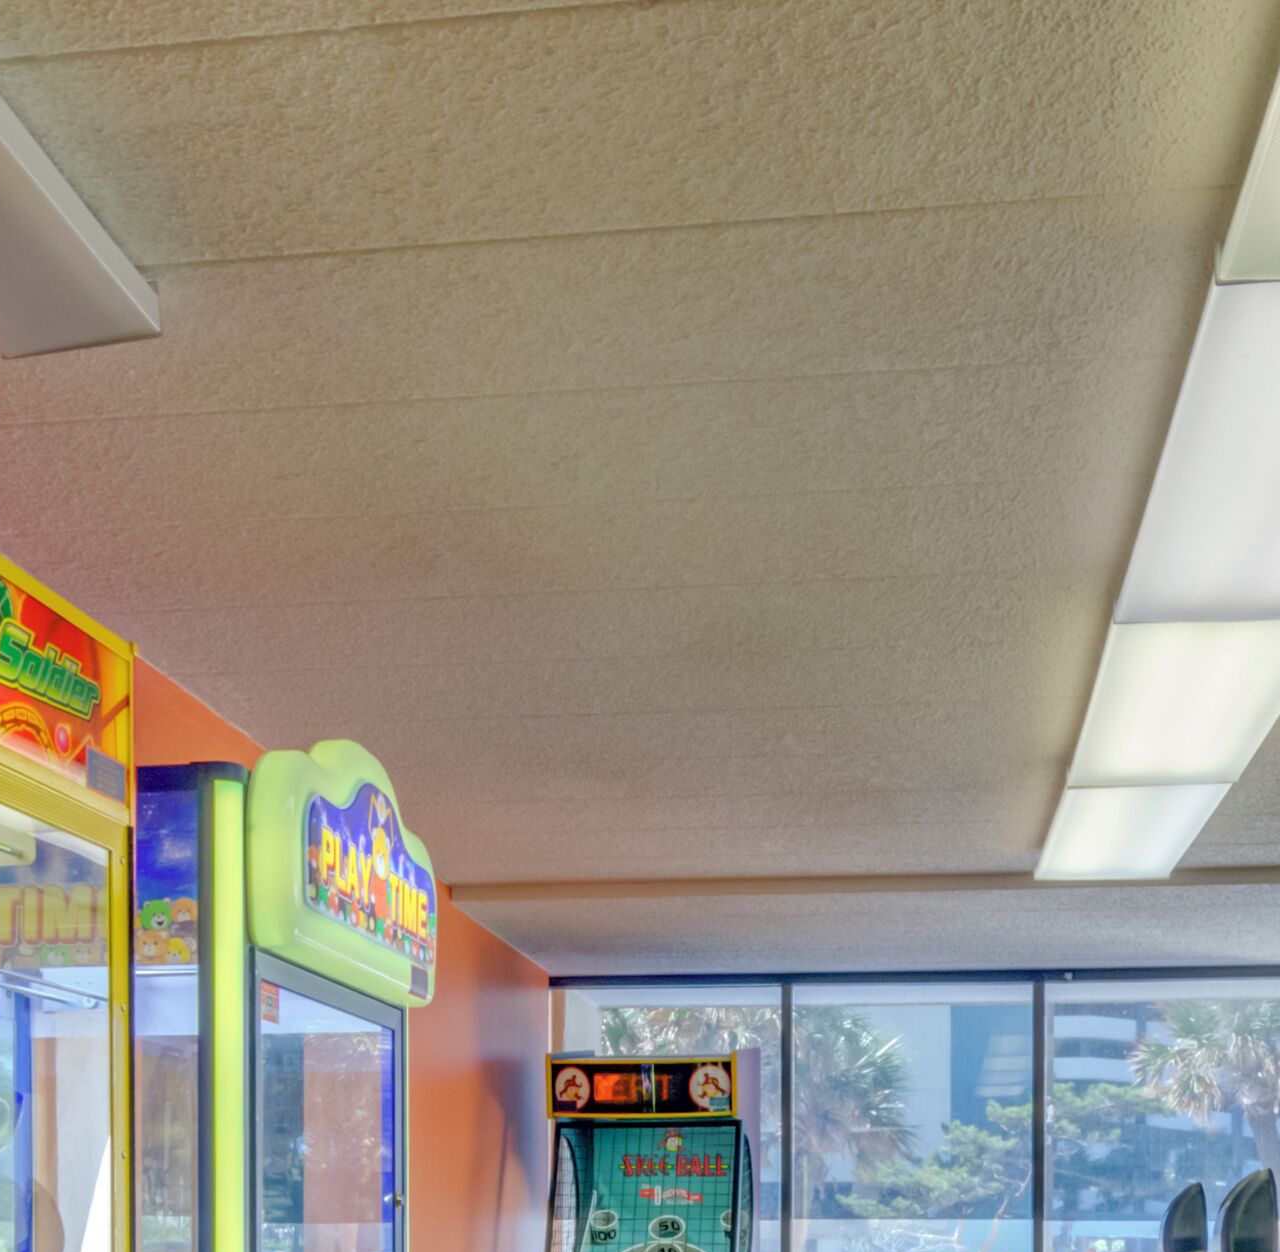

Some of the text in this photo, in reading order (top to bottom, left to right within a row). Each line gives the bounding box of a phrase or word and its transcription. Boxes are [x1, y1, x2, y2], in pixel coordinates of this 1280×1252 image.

[321, 827, 428, 941] PLAY TIME
[676, 1153, 727, 1176] BALL
[659, 1221, 680, 1231] 50
[592, 1229, 617, 1241] 100
